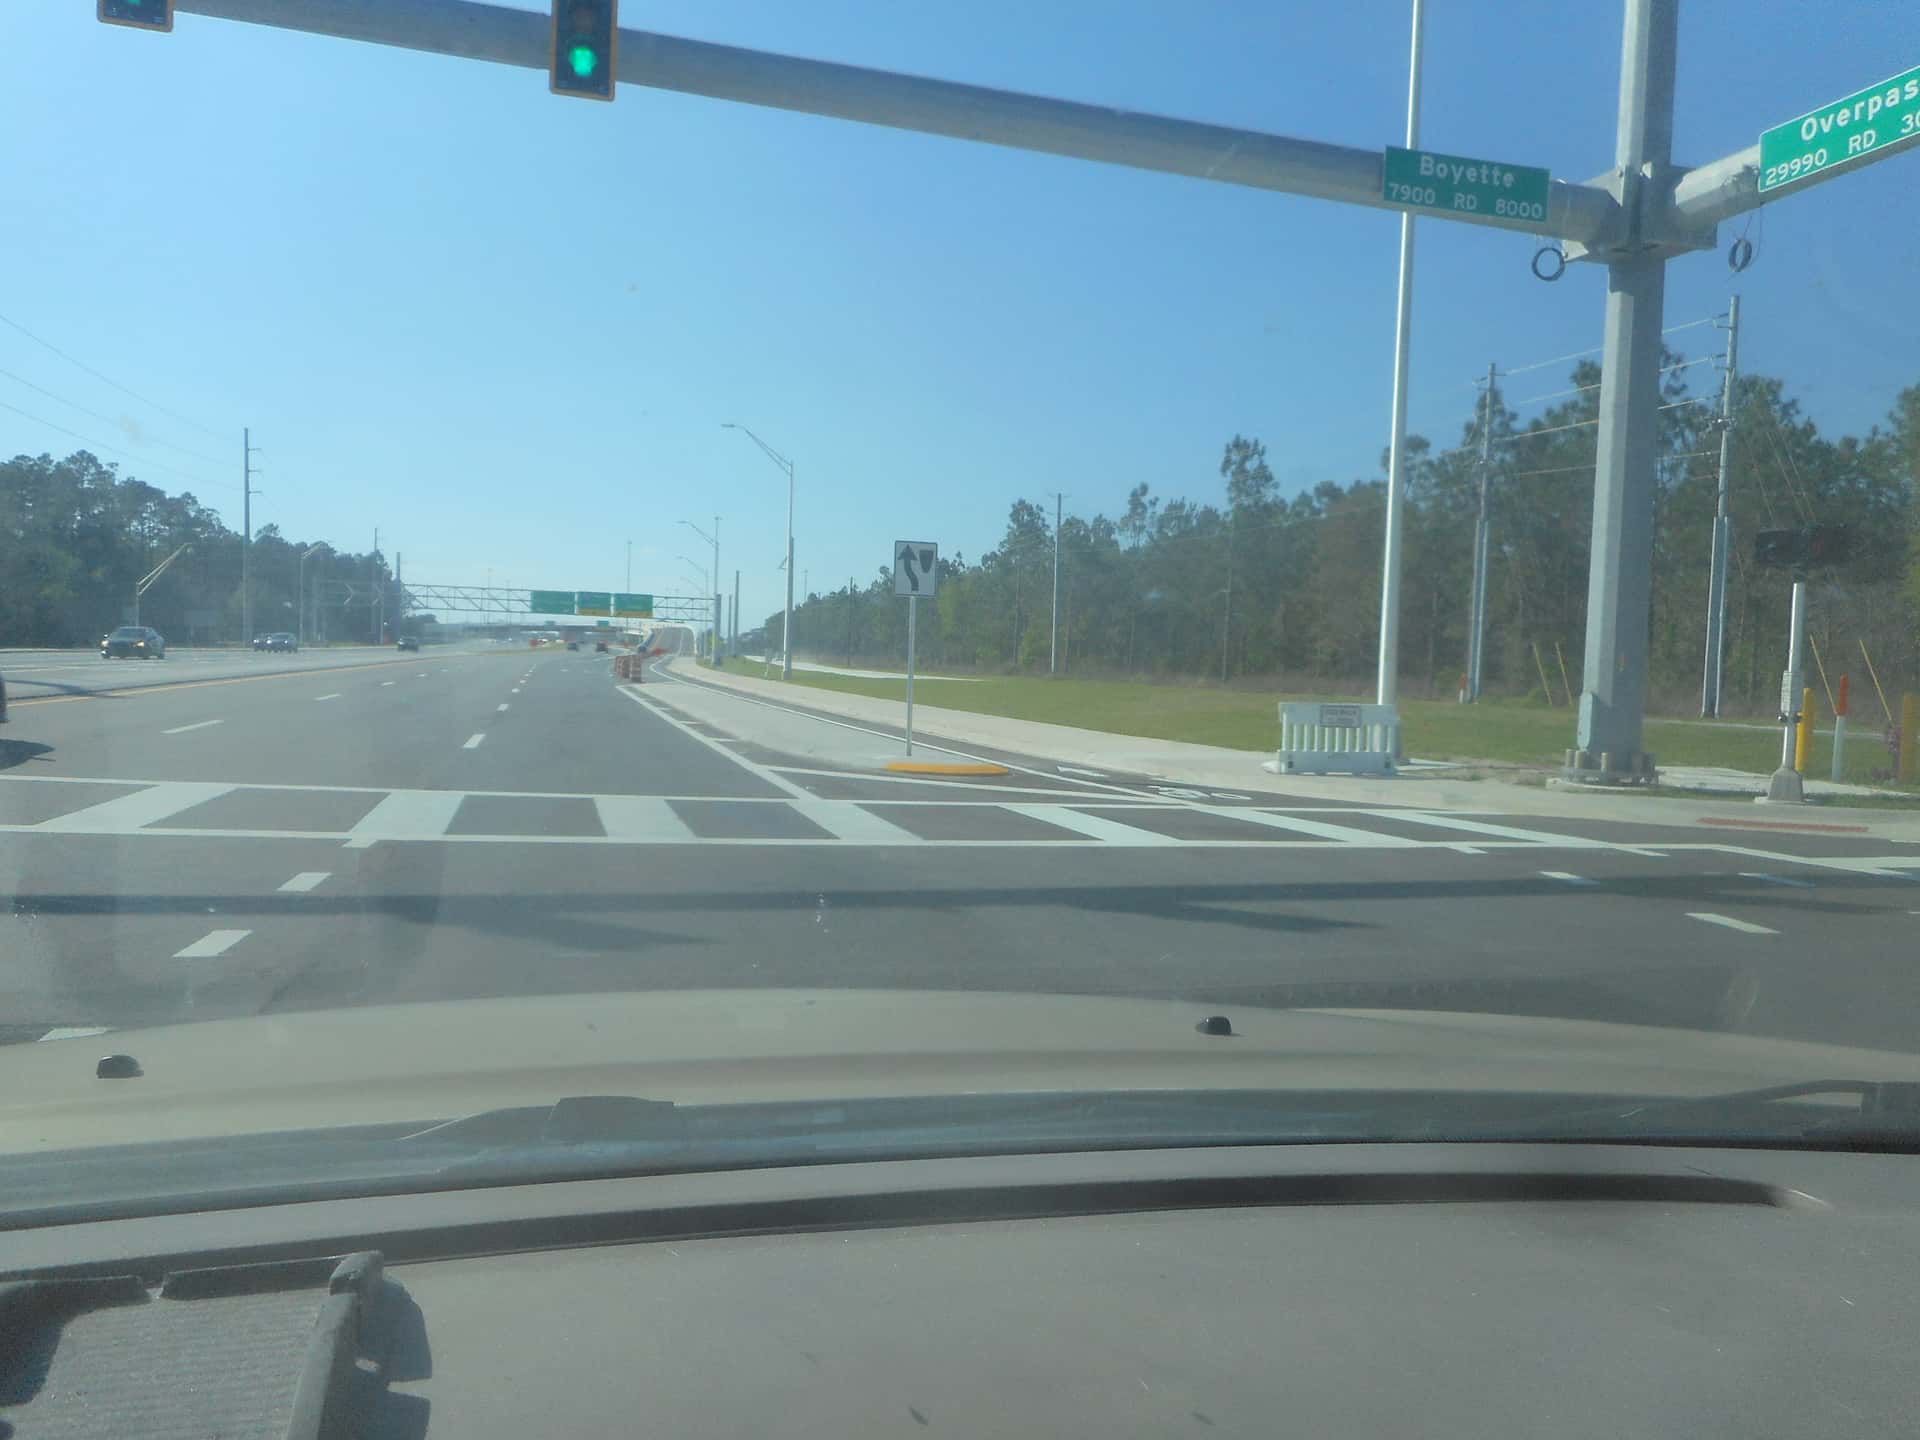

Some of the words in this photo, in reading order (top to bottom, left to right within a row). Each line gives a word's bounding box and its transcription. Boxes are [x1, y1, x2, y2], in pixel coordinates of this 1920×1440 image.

[1420, 155, 1514, 188] Boyette
[1766, 148, 1827, 186] 29990
[1848, 129, 1876, 155] RD
[1388, 183, 1436, 205] 7900
[1454, 193, 1478, 210] RD
[1496, 198, 1543, 219] 8000
